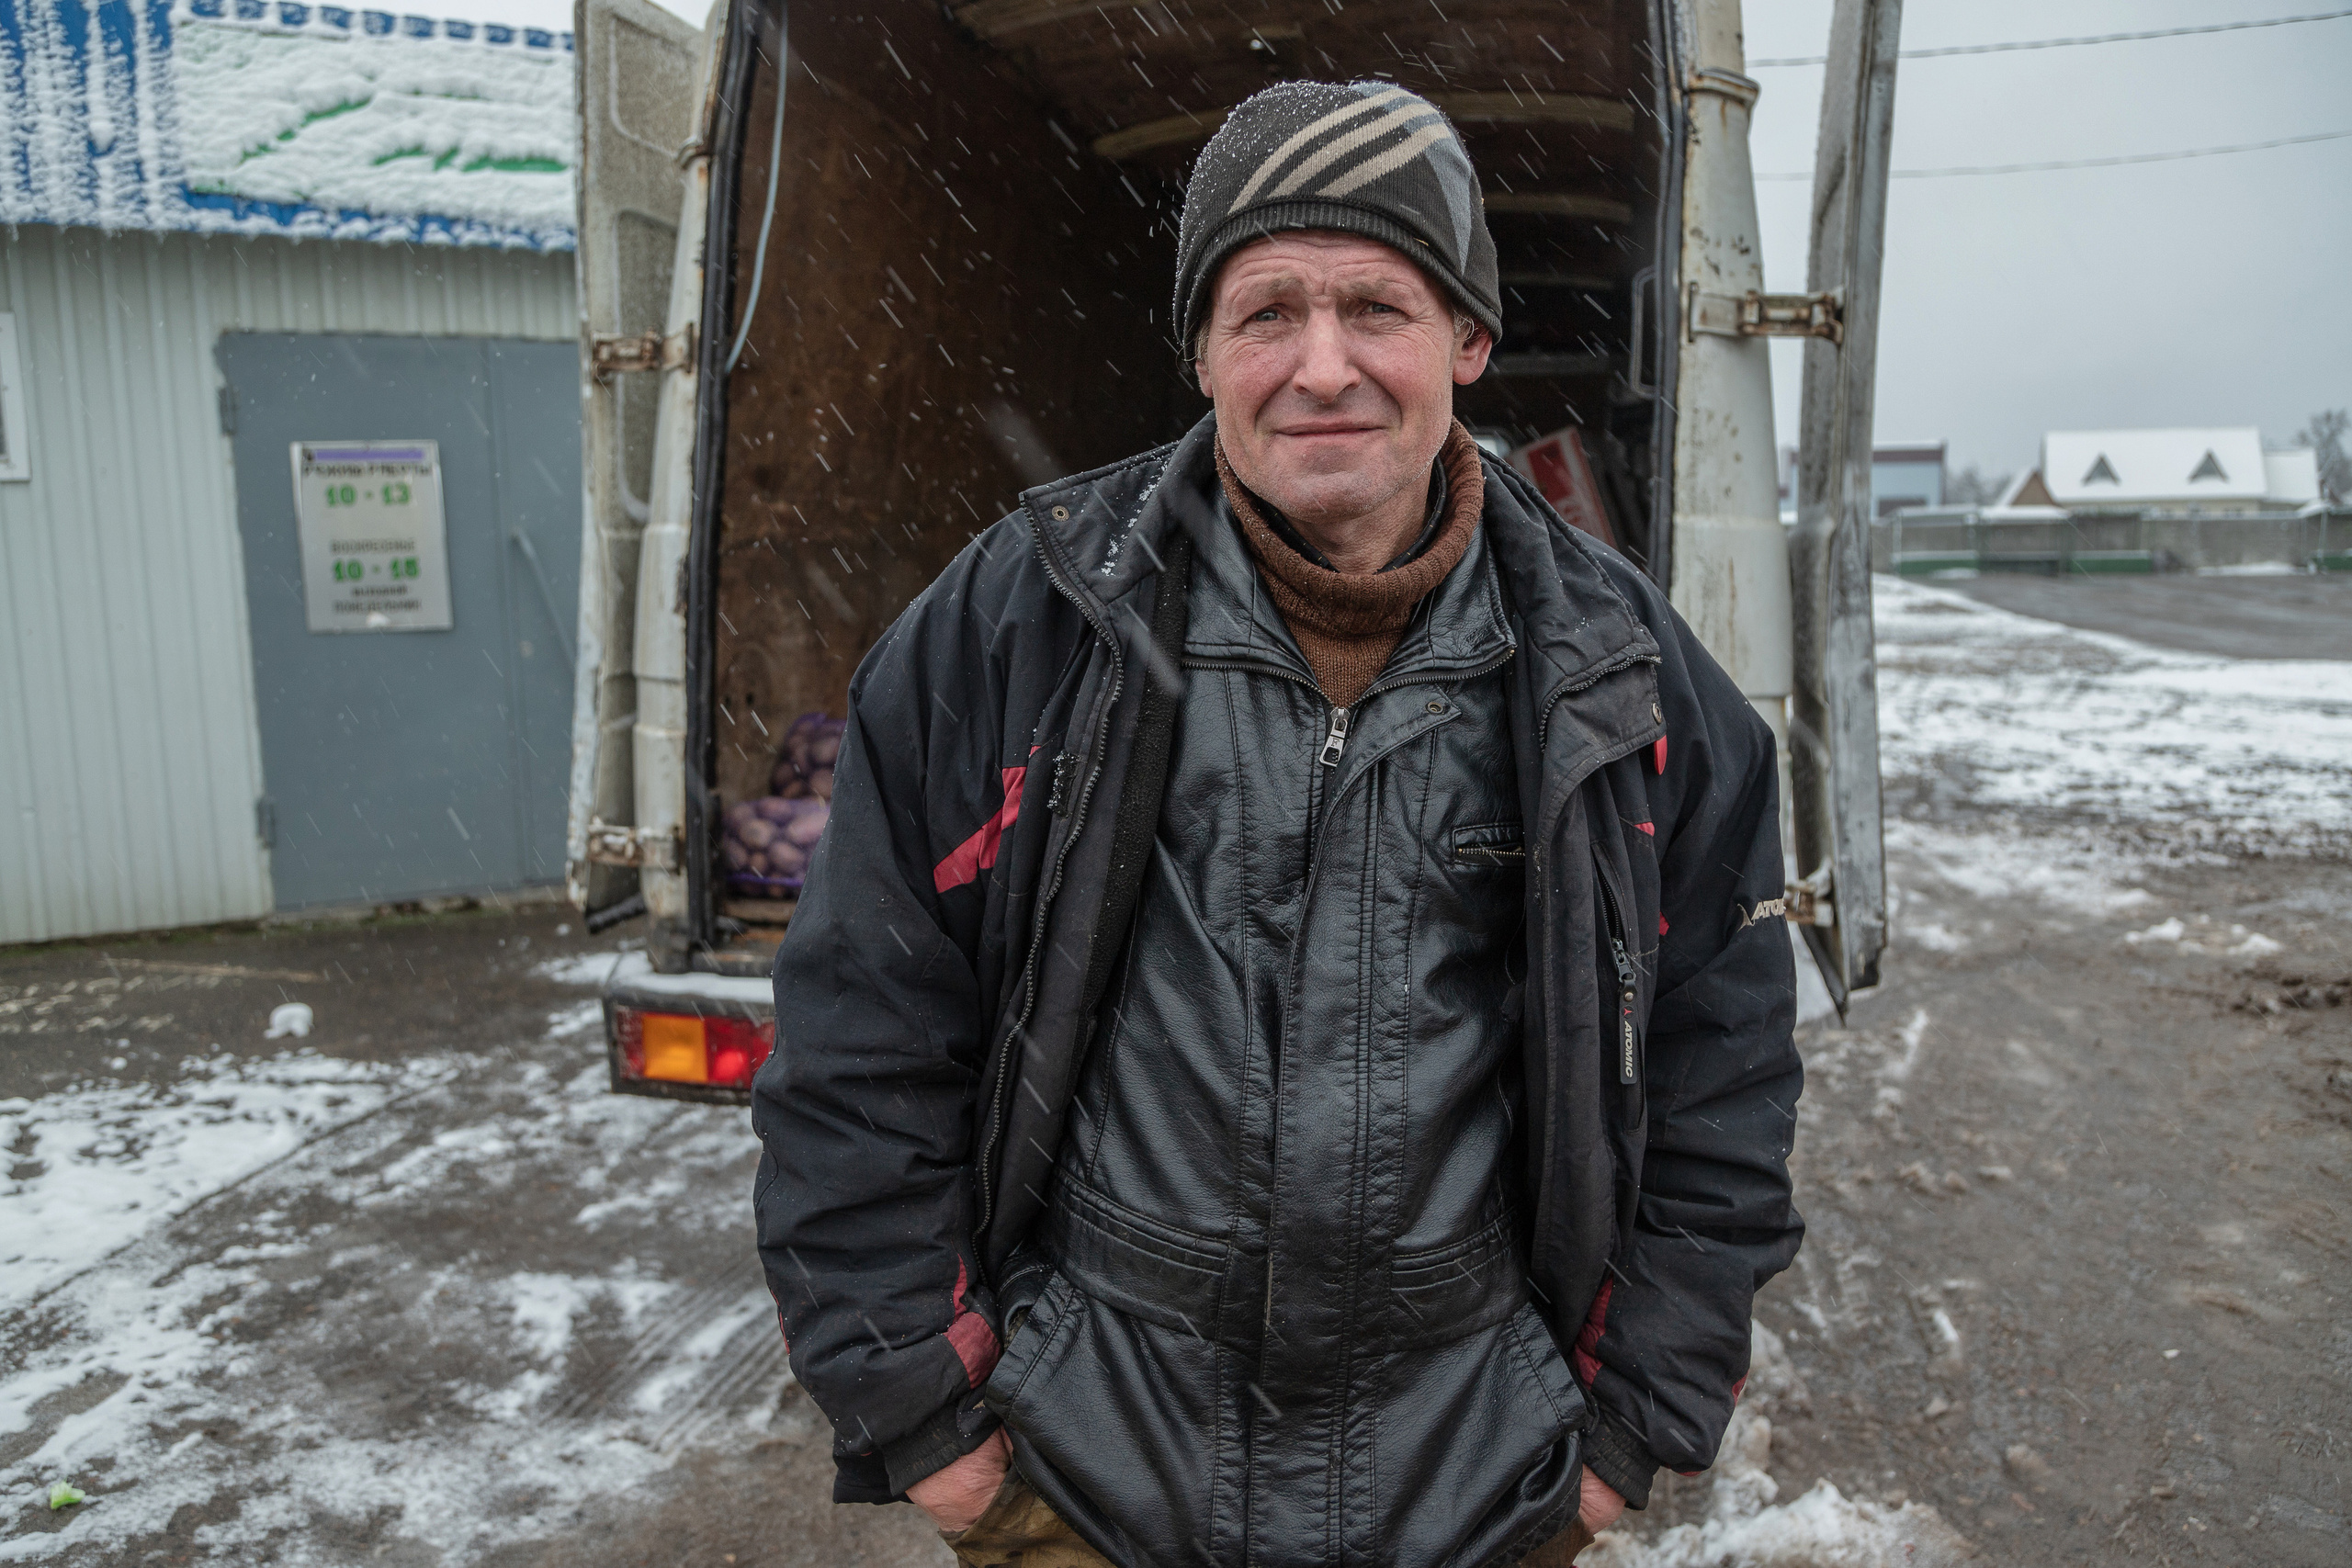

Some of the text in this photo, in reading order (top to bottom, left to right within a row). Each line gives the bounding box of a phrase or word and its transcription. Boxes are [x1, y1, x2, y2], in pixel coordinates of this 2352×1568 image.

[325, 483, 356, 506] 10
[333, 559, 364, 581] 10
[1624, 1021, 1634, 1077] ATOMIC
